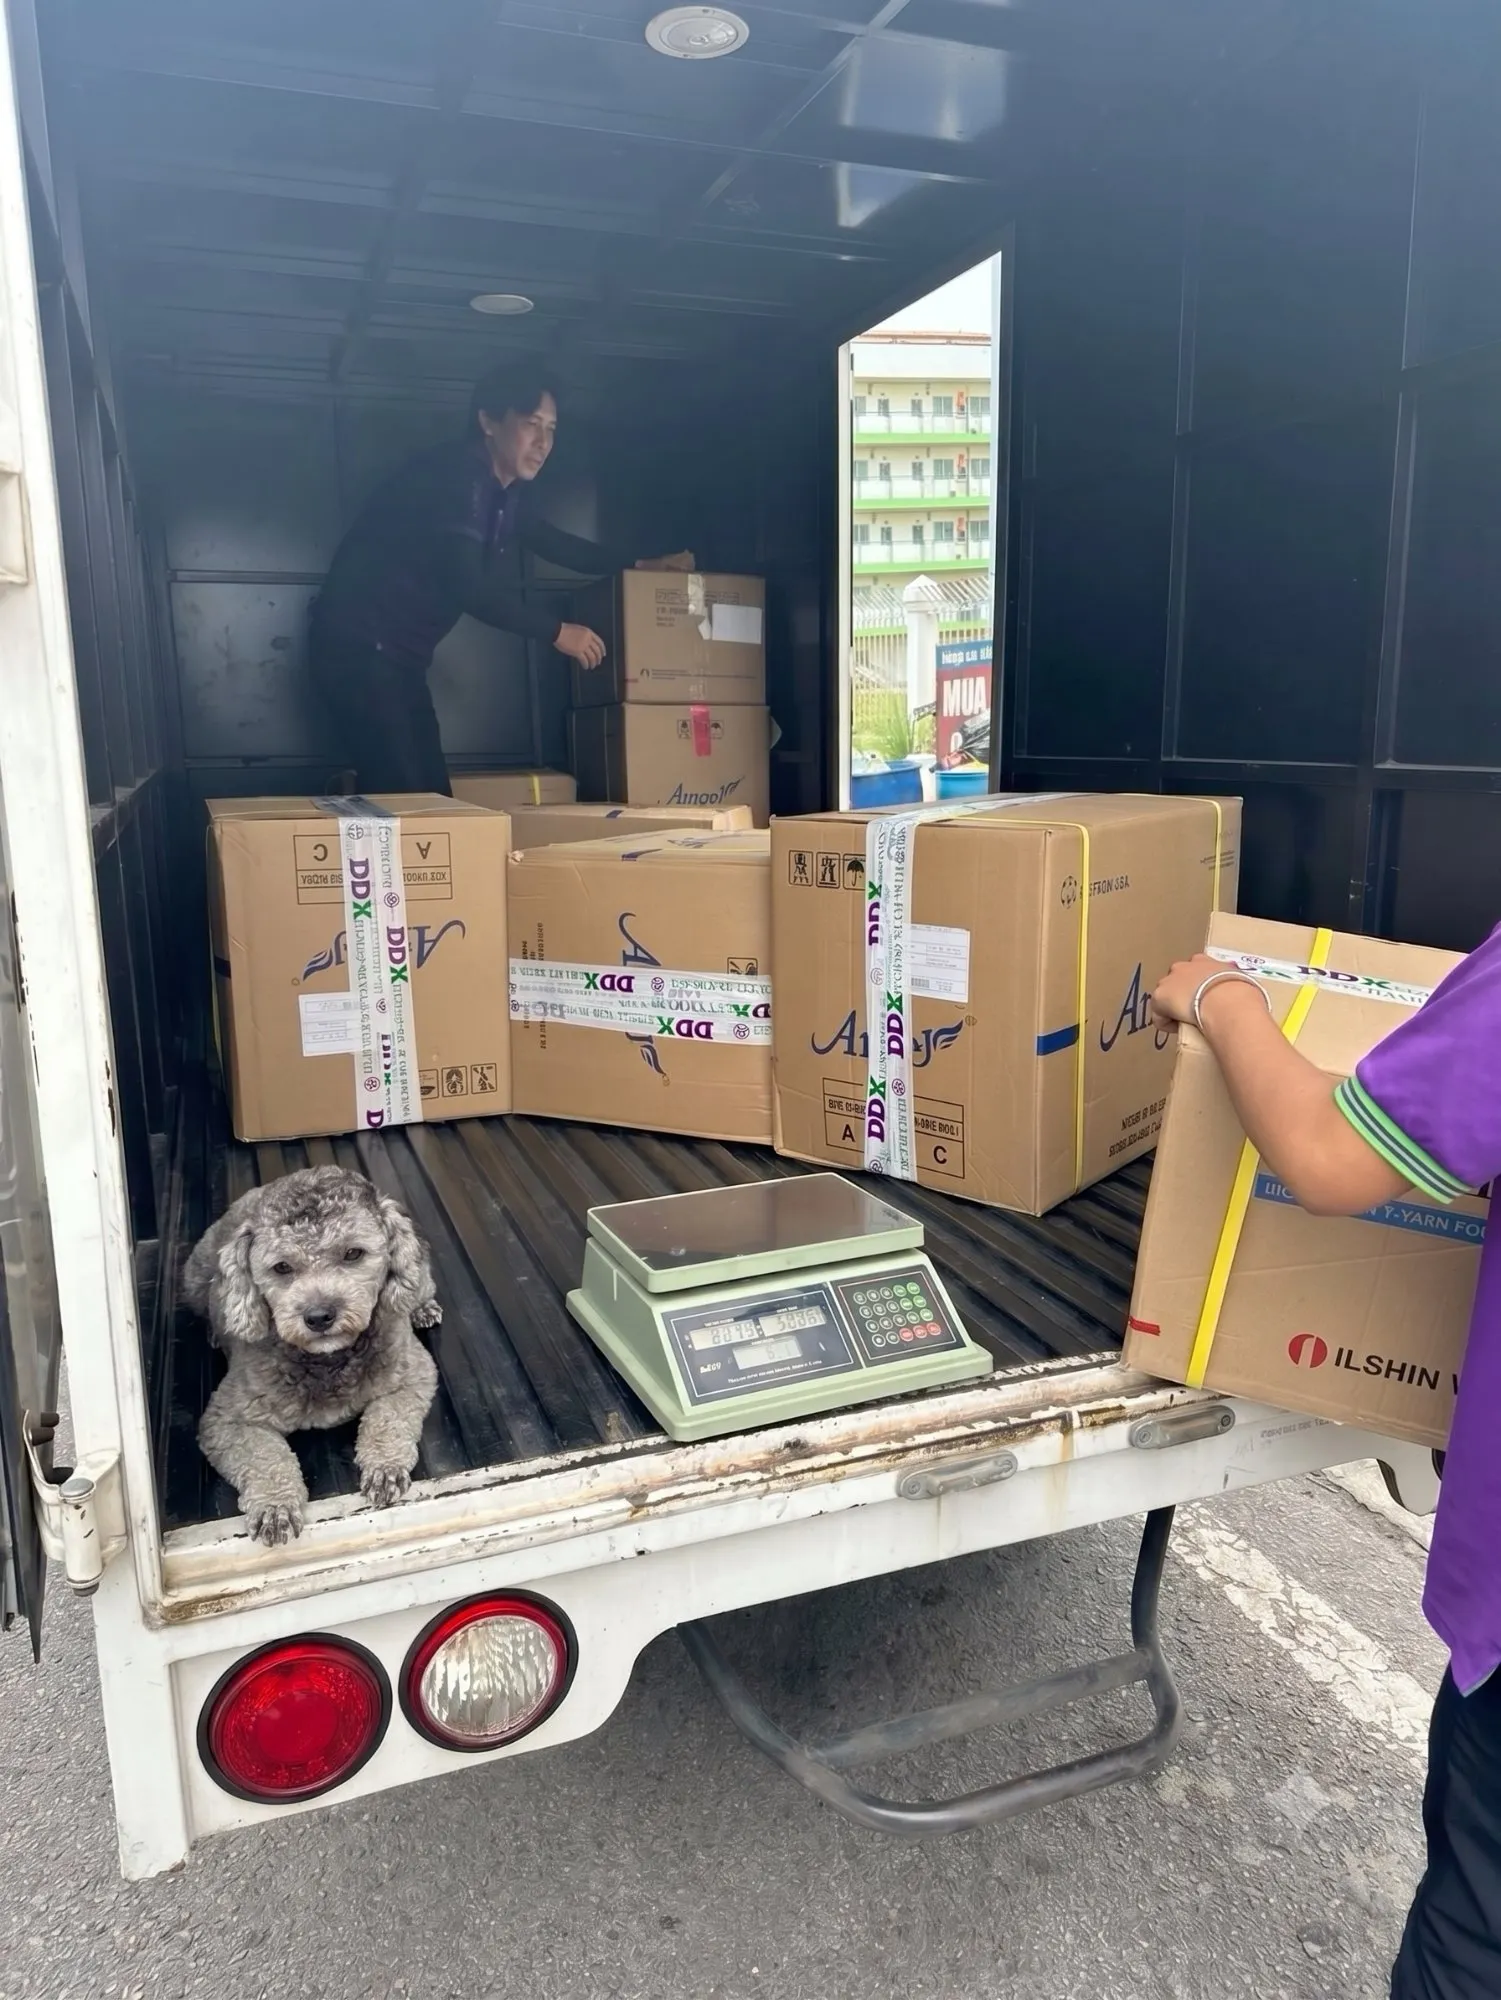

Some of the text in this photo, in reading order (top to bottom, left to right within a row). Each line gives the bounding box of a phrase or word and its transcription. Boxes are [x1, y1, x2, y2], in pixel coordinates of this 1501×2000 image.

[943, 676, 987, 717] MUA
[415, 841, 432, 860] A
[349, 857, 373, 920] DDX
[386, 926, 409, 985] DDX
[583, 972, 636, 994] DDX
[656, 1015, 714, 1040] DDX
[886, 991, 905, 1060] DDX
[867, 1075, 887, 1143] DDX
[841, 1123, 856, 1143] A
[933, 1145, 948, 1165] C
[1333, 1346, 1441, 1391] ILSHIN
